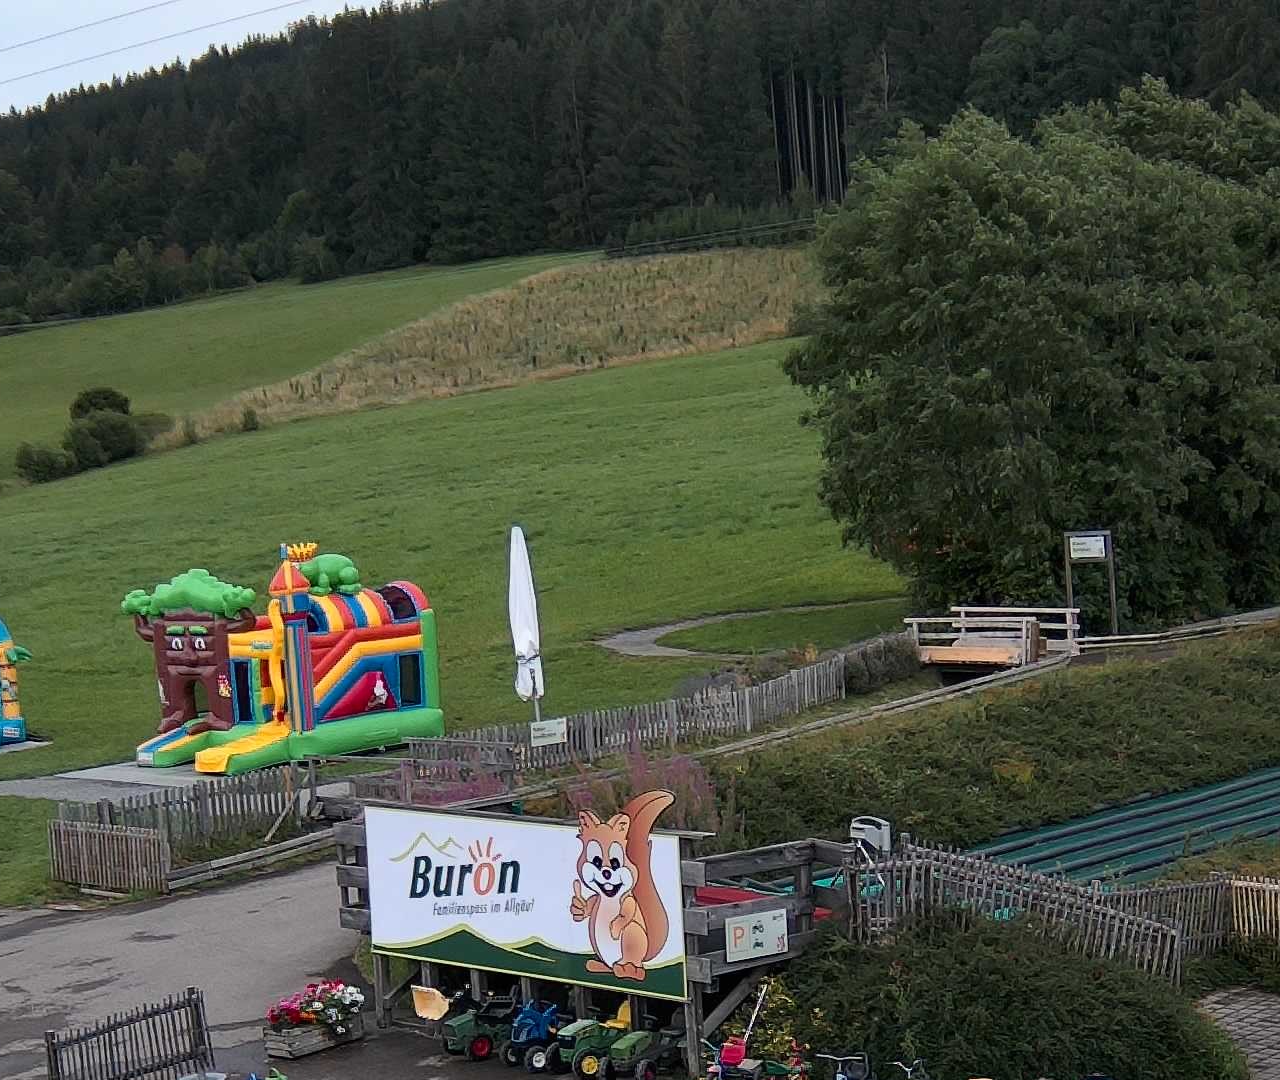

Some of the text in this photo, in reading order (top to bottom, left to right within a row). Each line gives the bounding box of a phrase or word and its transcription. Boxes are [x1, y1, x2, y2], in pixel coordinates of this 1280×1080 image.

[408, 855, 521, 899] Buron
[490, 902, 501, 913] im
[733, 926, 745, 948] P
